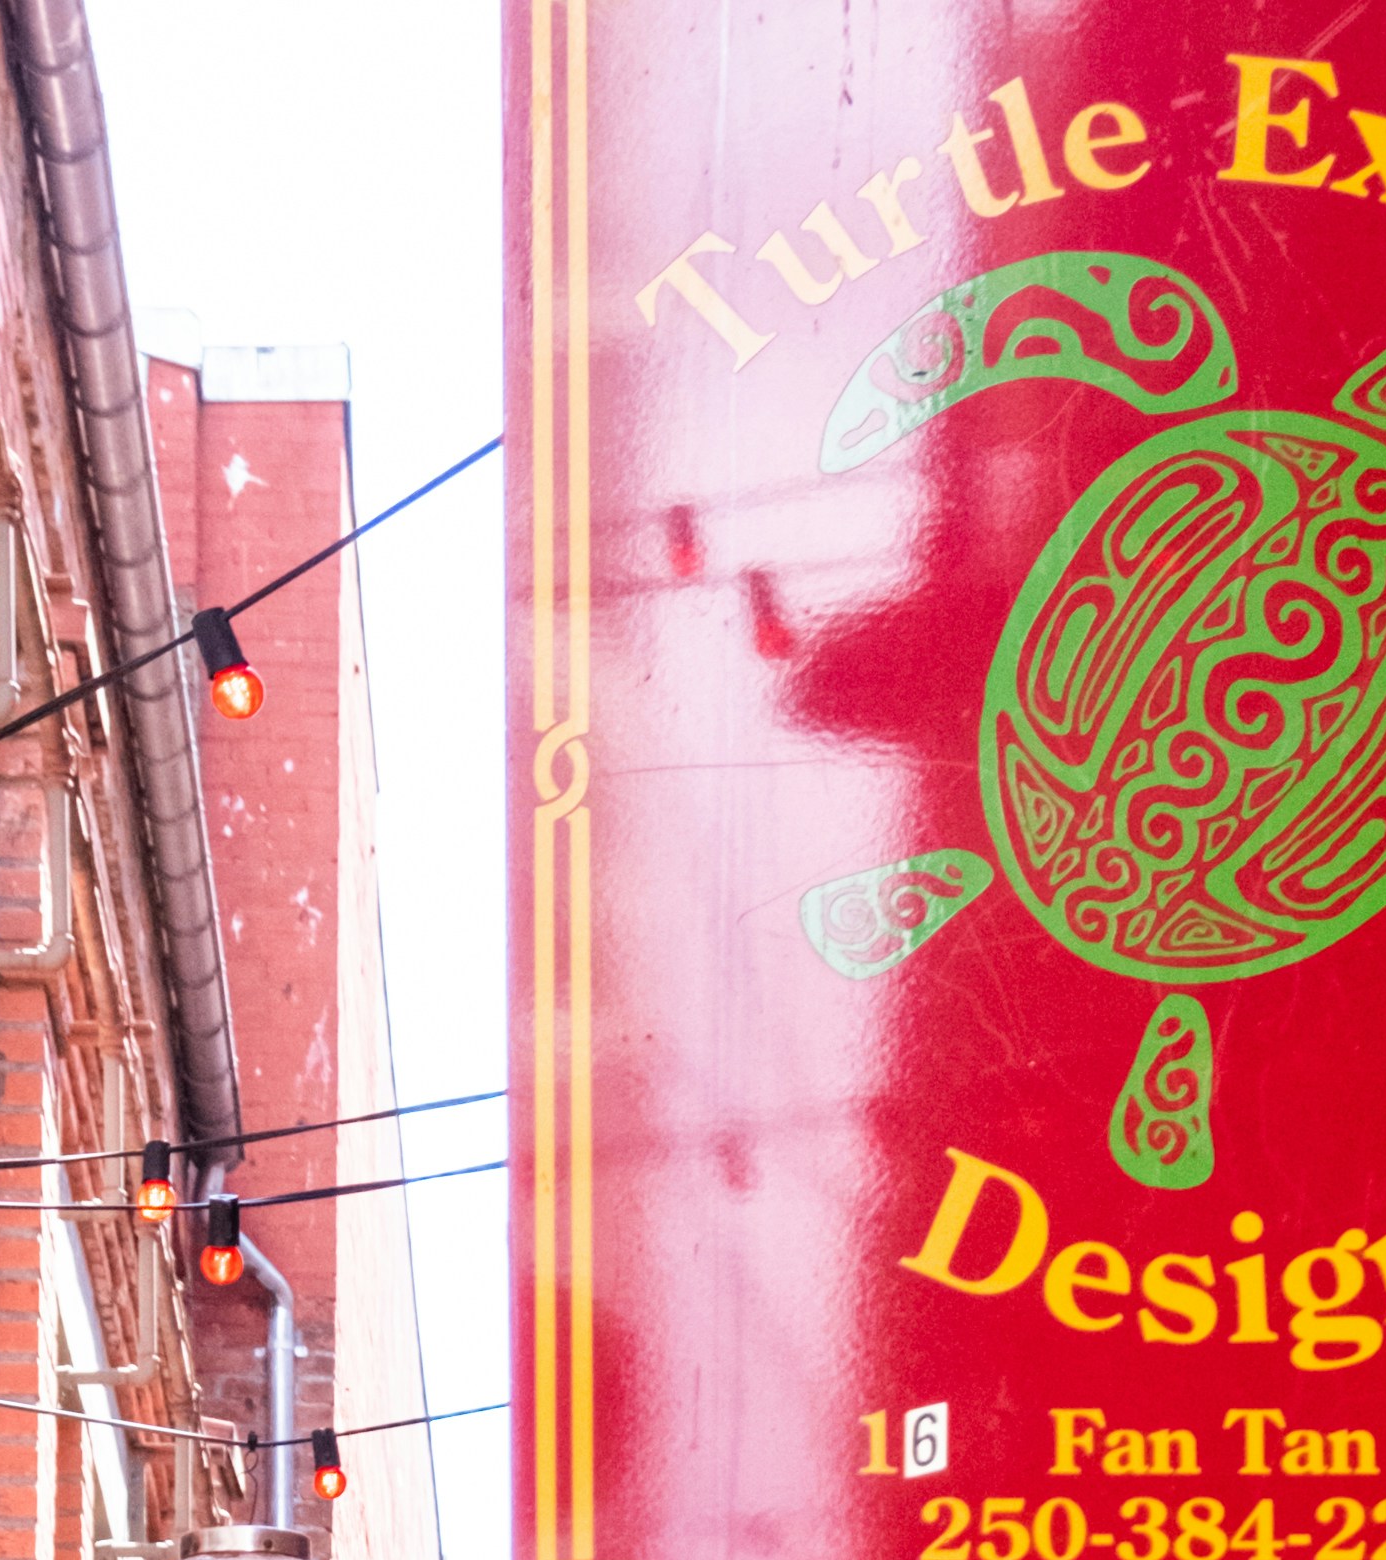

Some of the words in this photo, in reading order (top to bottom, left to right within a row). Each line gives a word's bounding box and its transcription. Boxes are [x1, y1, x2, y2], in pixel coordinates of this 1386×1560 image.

[635, 77, 1153, 373] Turtle
[1048, 1407, 1201, 1475] Fan
[1223, 1407, 1380, 1475] Tan
